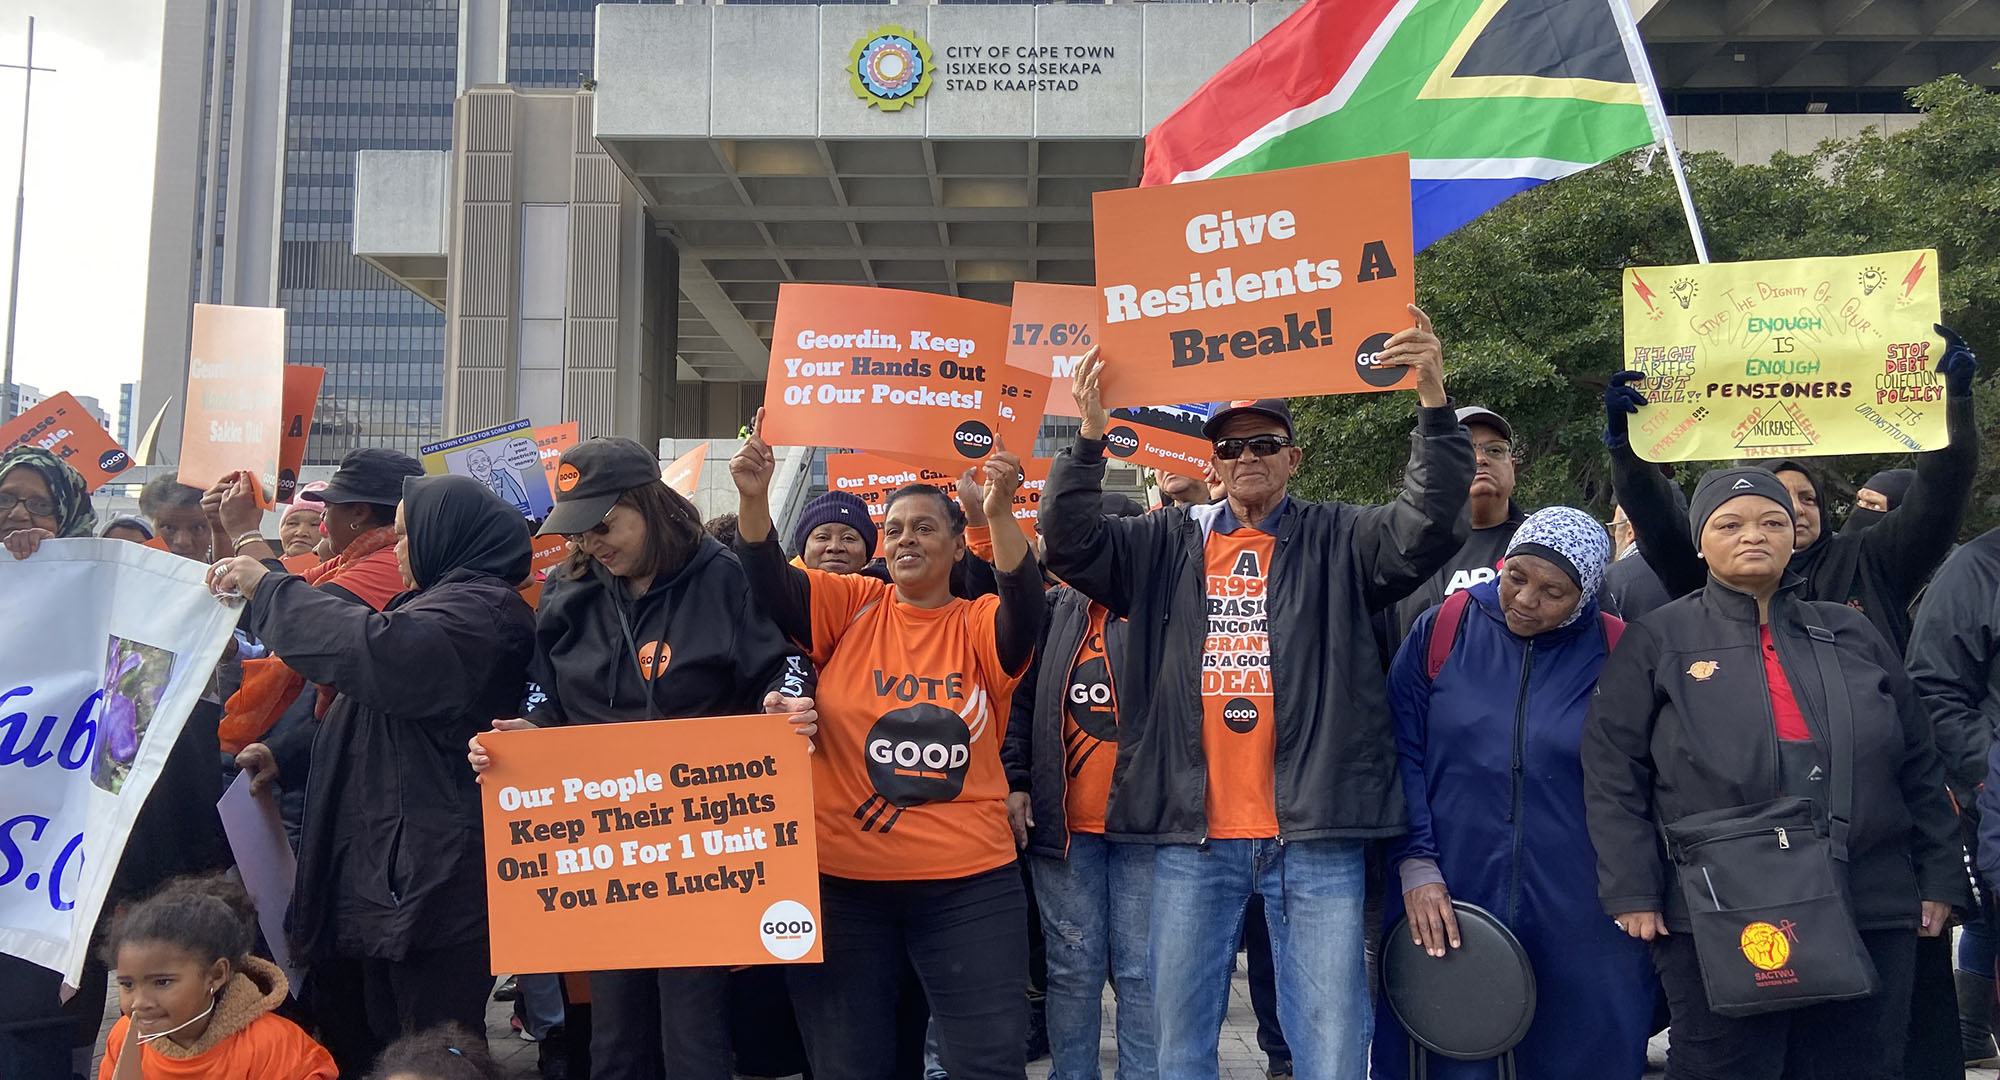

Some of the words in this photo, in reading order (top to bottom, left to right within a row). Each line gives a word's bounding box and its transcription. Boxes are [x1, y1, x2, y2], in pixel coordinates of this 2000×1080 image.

[946, 46, 982, 58] CITY
[988, 46, 1011, 58] OF
[1016, 46, 1059, 58] CAPE
[1064, 46, 1115, 58] TOWN
[946, 63, 1011, 74] ISIXEKO
[1017, 63, 1102, 74] SASEKAPA
[946, 79, 987, 91] STAD
[994, 79, 1079, 91] KAAPSTAD
[1185, 209, 1296, 254] Give
[1103, 258, 1343, 324] Residents
[1357, 240, 1397, 283] A
[1748, 316, 1822, 333] ENOUGH
[797, 329, 903, 352] Geordin,
[909, 330, 976, 358] Keep
[1012, 323, 1092, 346] 17.6%
[1169, 307, 1334, 368] Break!
[1634, 345, 1697, 362] HIGH
[1773, 336, 1795, 353] IS
[1887, 341, 1930, 359] STOP
[784, 358, 844, 377] Your
[851, 356, 931, 378] Hands
[939, 360, 986, 382] Out
[1746, 358, 1820, 376] ENOUGH
[1885, 356, 1929, 374] DEBT
[1630, 375, 1690, 390] MUST
[1875, 370, 1938, 391] COLLECTION
[784, 385, 814, 405] Of
[817, 384, 865, 404] Our
[871, 384, 983, 409] Pockets!
[1706, 382, 1852, 399] PENSIONERS
[1877, 385, 1944, 405] POLICY
[288, 415, 302, 437] A
[1641, 407, 1669, 436] STOP
[1731, 407, 1763, 440] STOP
[422, 444, 440, 455] CAPE
[439, 439, 459, 450] TOWN
[458, 434, 478, 446] CARES
[478, 430, 491, 441] FOR
[490, 427, 508, 438] SOME
[507, 425, 517, 434] OF
[516, 420, 530, 431] YOU
[513, 440, 528, 448] want
[955, 431, 992, 445] GOOD
[1107, 433, 1138, 447] GOOD
[507, 450, 537, 462] electricity
[515, 446, 528, 454] your
[100, 452, 126, 469] GOOD
[559, 472, 578, 482] GOOD
[836, 477, 865, 488] Our
[868, 471, 917, 486] People
[1233, 551, 1260, 577] A
[1208, 576, 1268, 598] R99
[1207, 598, 1268, 617] BASI
[1204, 655, 1217, 667] IS
[1220, 655, 1233, 667] A
[873, 669, 964, 702] VOTE
[1224, 708, 1257, 719] GOOD
[869, 738, 969, 769] GOOD
[498, 785, 555, 811] Our
[562, 768, 663, 803] People
[669, 755, 777, 788] Cannot
[509, 816, 586, 845] Keep
[592, 803, 673, 834] Their
[681, 793, 776, 825] Lights
[497, 853, 548, 881] On!
[555, 844, 614, 875] R10
[620, 840, 671, 867] For
[678, 834, 695, 859] 1
[701, 826, 768, 856] Unit
[773, 821, 799, 847] If
[537, 886, 598, 912] You
[605, 878, 659, 904] Are
[665, 861, 766, 897] Lucky!
[762, 920, 813, 935] GOOD
[1754, 969, 1795, 980] SACTWU
